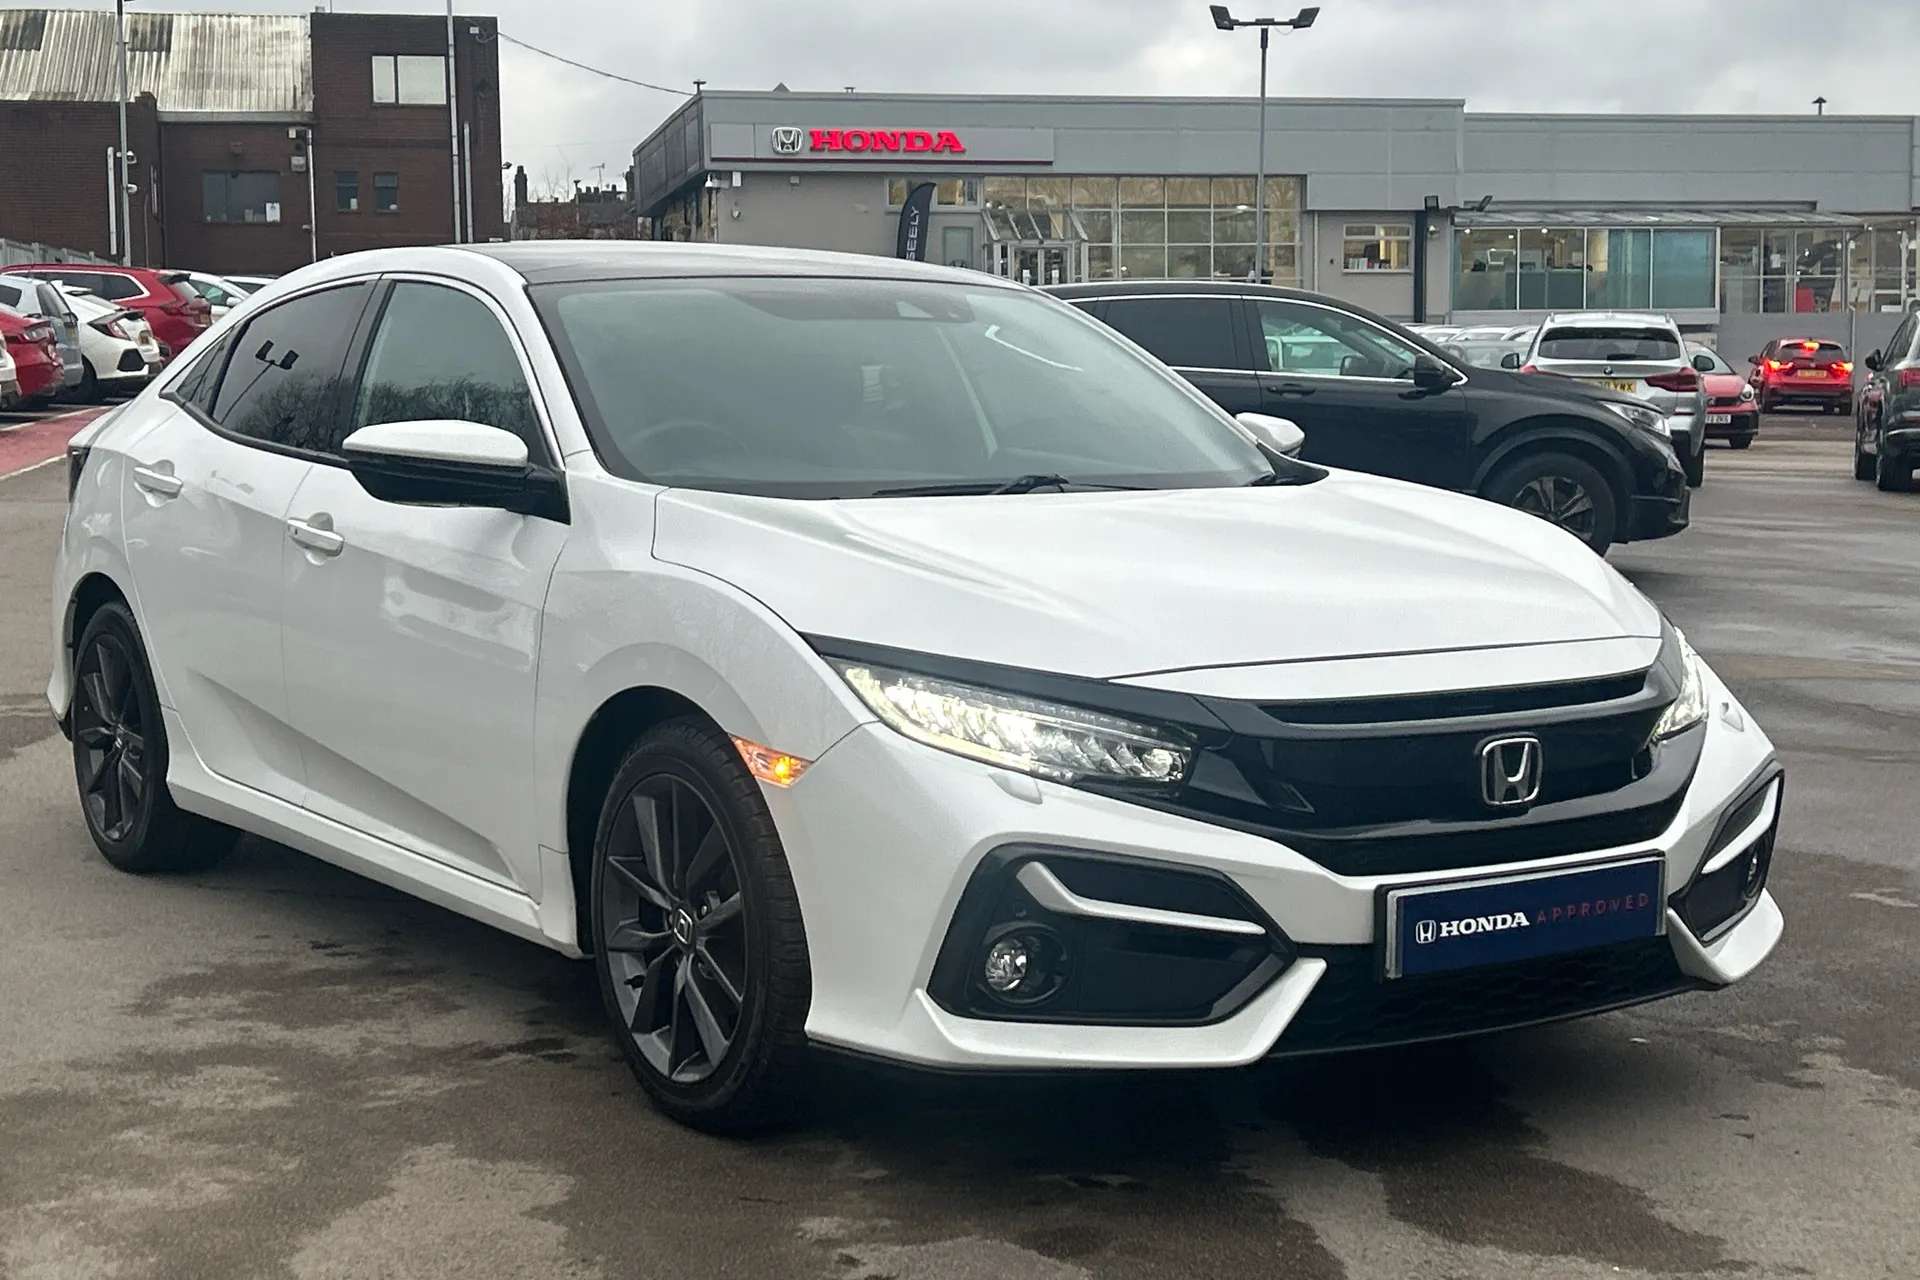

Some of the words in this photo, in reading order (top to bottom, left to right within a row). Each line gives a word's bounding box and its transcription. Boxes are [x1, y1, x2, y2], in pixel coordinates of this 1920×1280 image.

[809, 129, 965, 154] HONDA
[1439, 911, 1530, 938] HONDA
[1537, 892, 1650, 924] APPROVED
